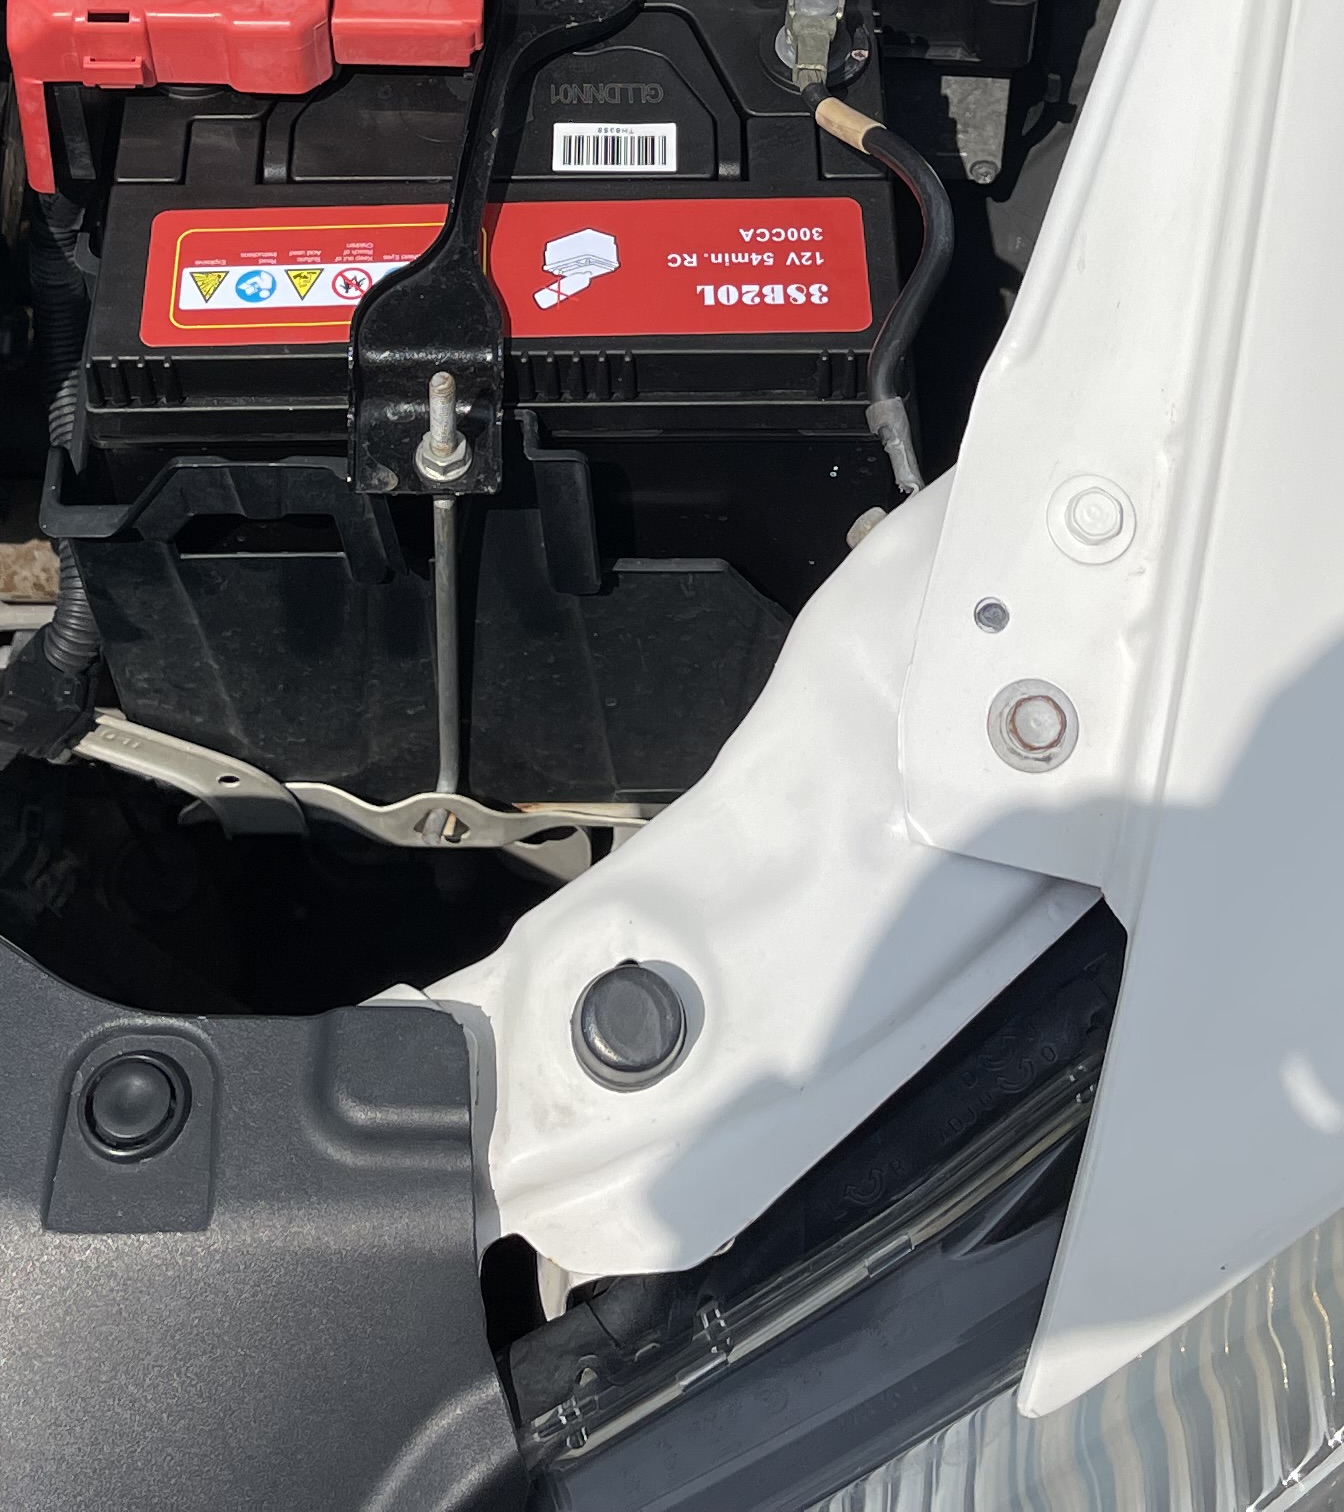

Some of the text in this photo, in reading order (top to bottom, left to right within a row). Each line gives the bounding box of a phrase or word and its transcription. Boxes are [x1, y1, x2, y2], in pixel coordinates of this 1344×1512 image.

[550, 82, 664, 105] GLLDNN01
[738, 227, 824, 243] 300CCA
[667, 251, 825, 268] 12V 54min. RC
[696, 283, 829, 306] 38B20L
